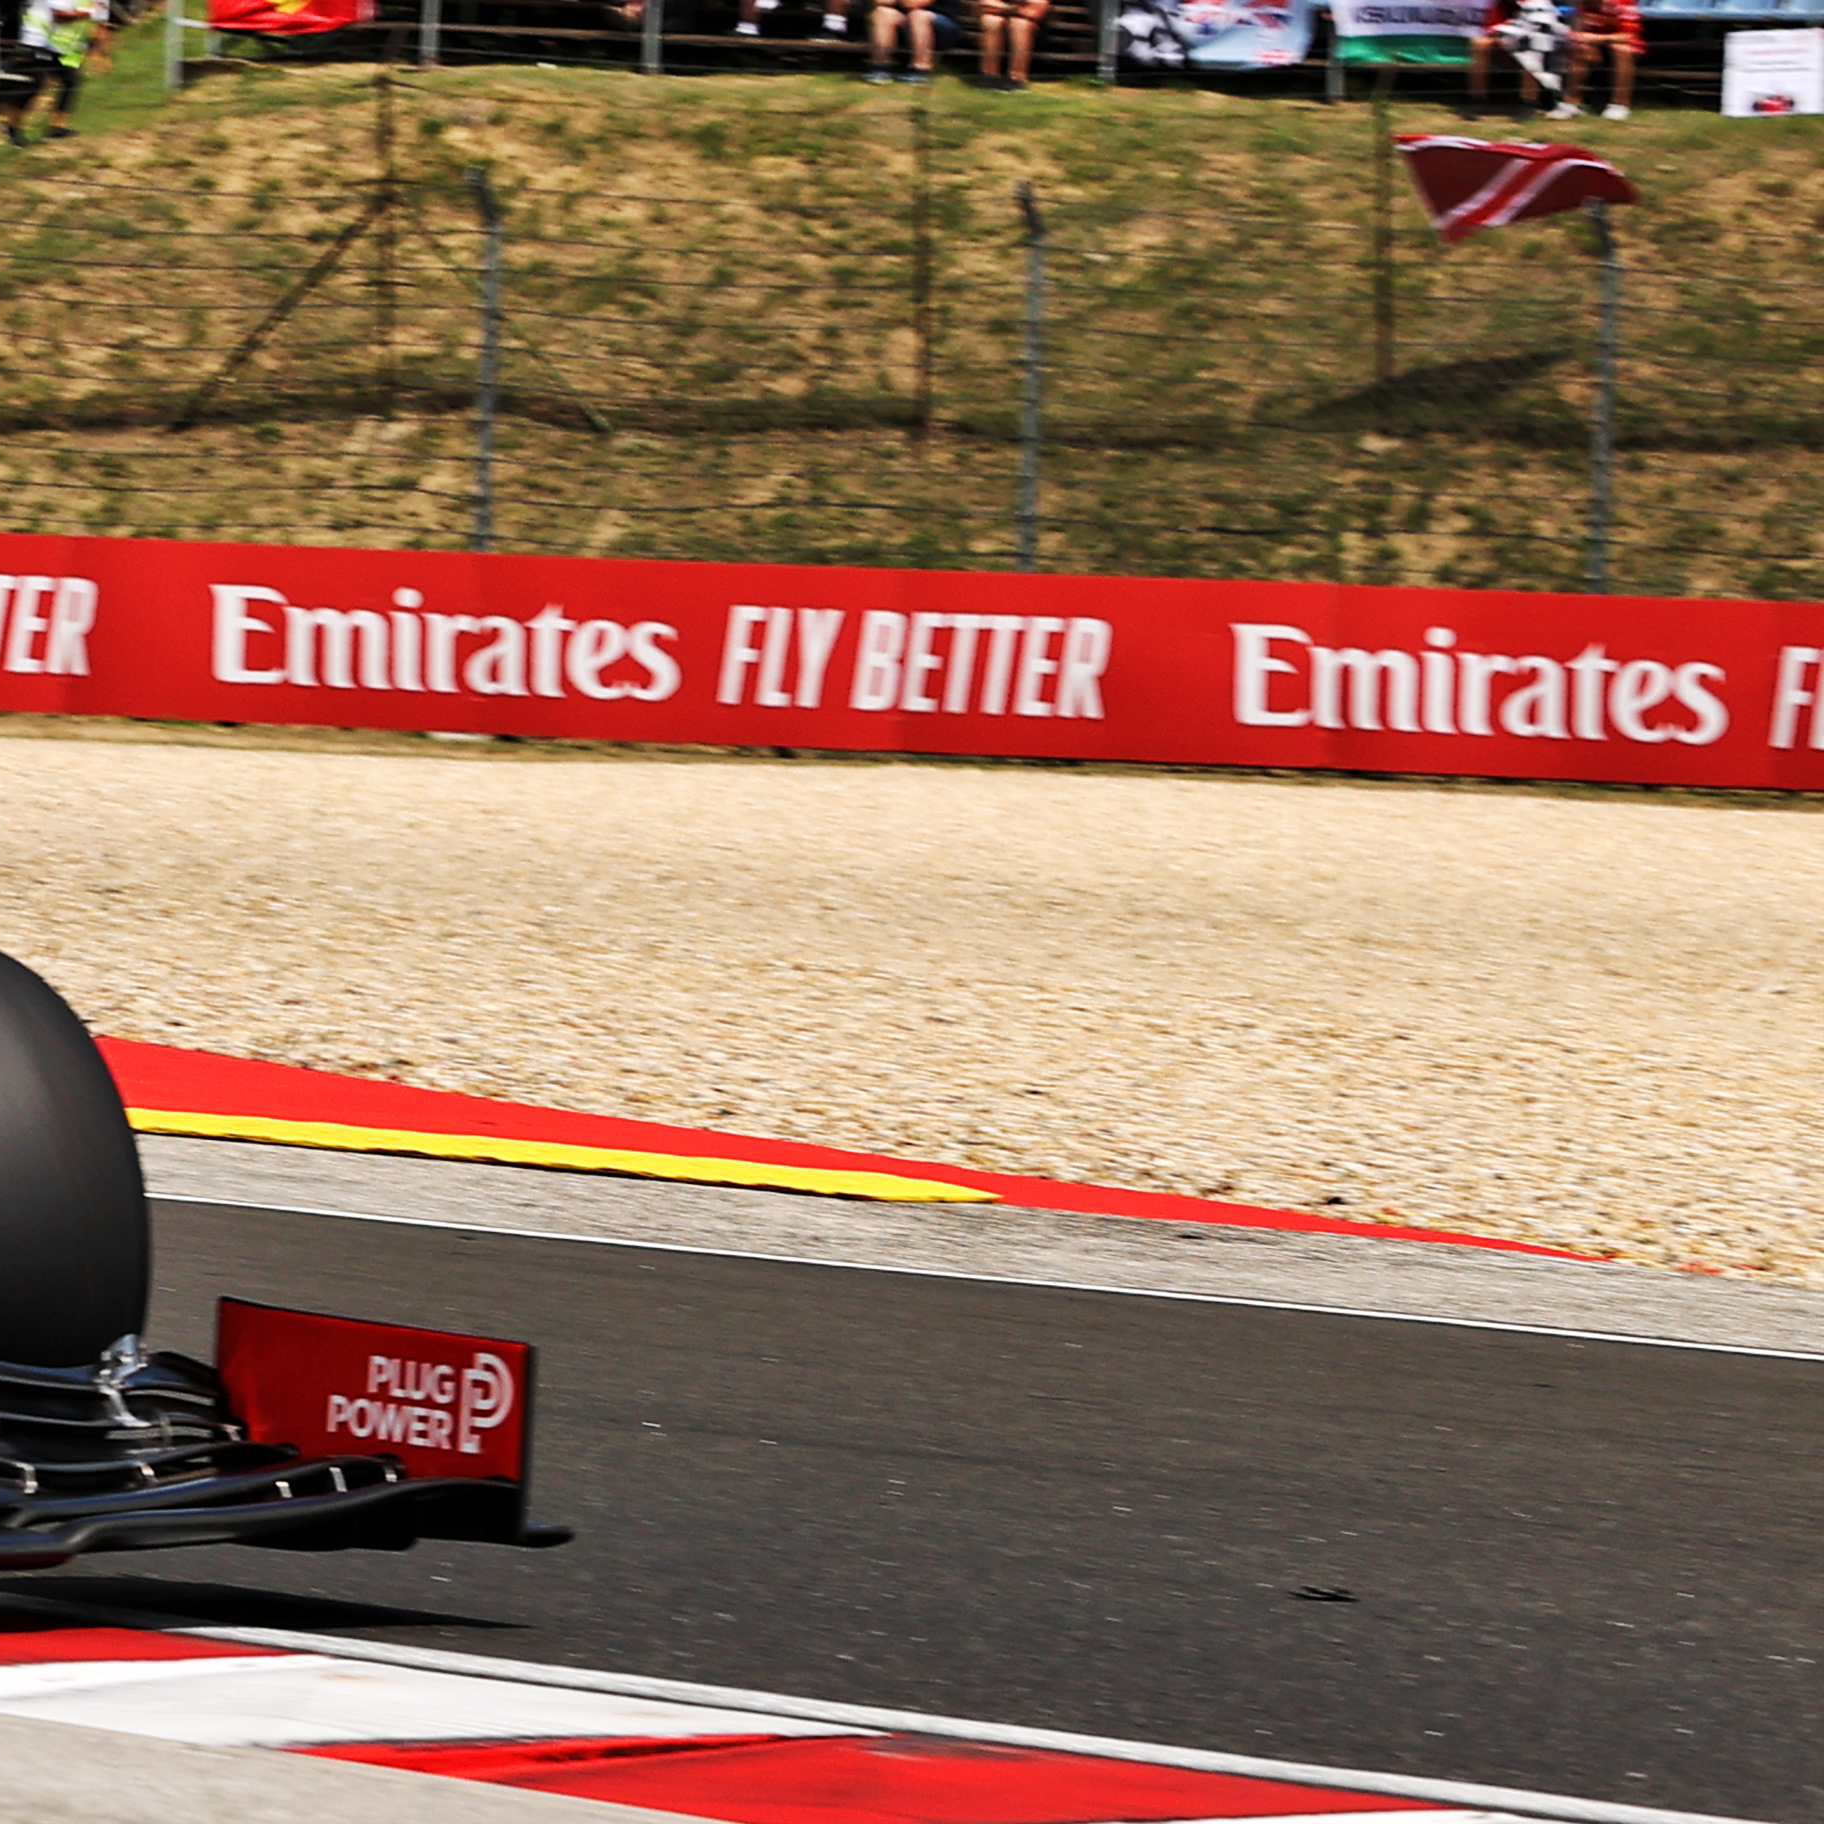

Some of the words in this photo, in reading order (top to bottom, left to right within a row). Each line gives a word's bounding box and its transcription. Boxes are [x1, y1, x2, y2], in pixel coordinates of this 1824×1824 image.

[209, 583, 682, 702] Emirates
[715, 604, 846, 709] FLY
[848, 610, 1114, 720] BETTER
[1231, 622, 1729, 746] Emirates
[1768, 644, 1824, 750] F
[325, 1394, 455, 1451] POWER
[366, 1354, 457, 1405] PLUG
